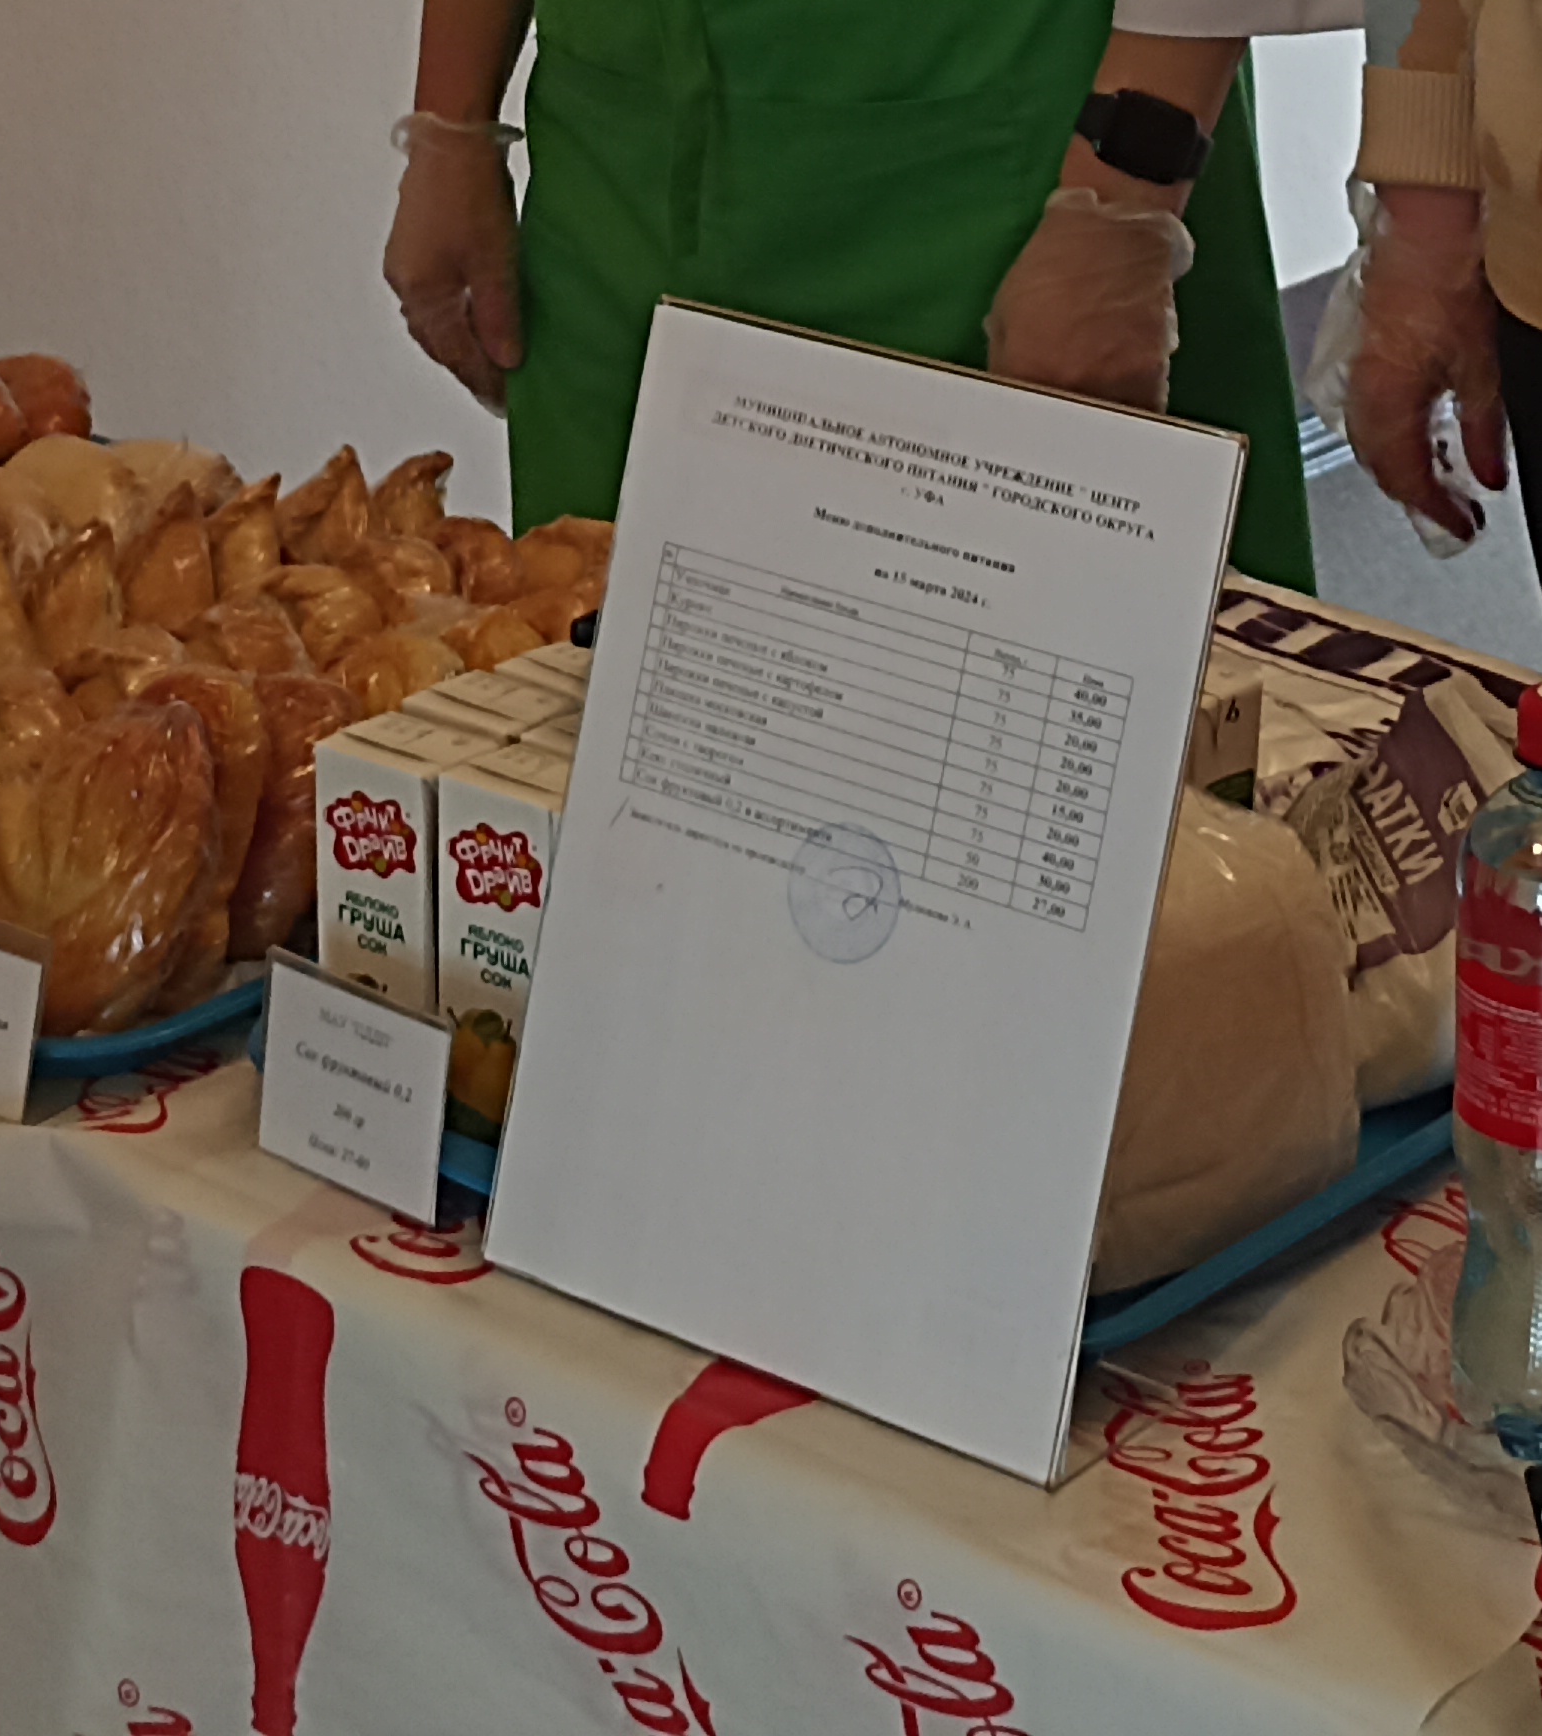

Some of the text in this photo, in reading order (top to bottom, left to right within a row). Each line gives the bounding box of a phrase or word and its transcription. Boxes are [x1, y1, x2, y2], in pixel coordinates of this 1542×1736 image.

[972, 457, 1075, 498] УЧРЕЖДЕНИЕ
[906, 462, 979, 495] ПИТАНИЯ
[990, 484, 1093, 525] ГОРОДСКОГО
[1093, 512, 1156, 542] ОКРУГА
[912, 486, 945, 509] УФА
[338, 905, 405, 942] ГРУША
[357, 933, 387, 956] СОК
[460, 938, 531, 977] ГРУША
[480, 968, 512, 989] СОК
[1102, 1372, 1297, 1631] Coca-Cola
